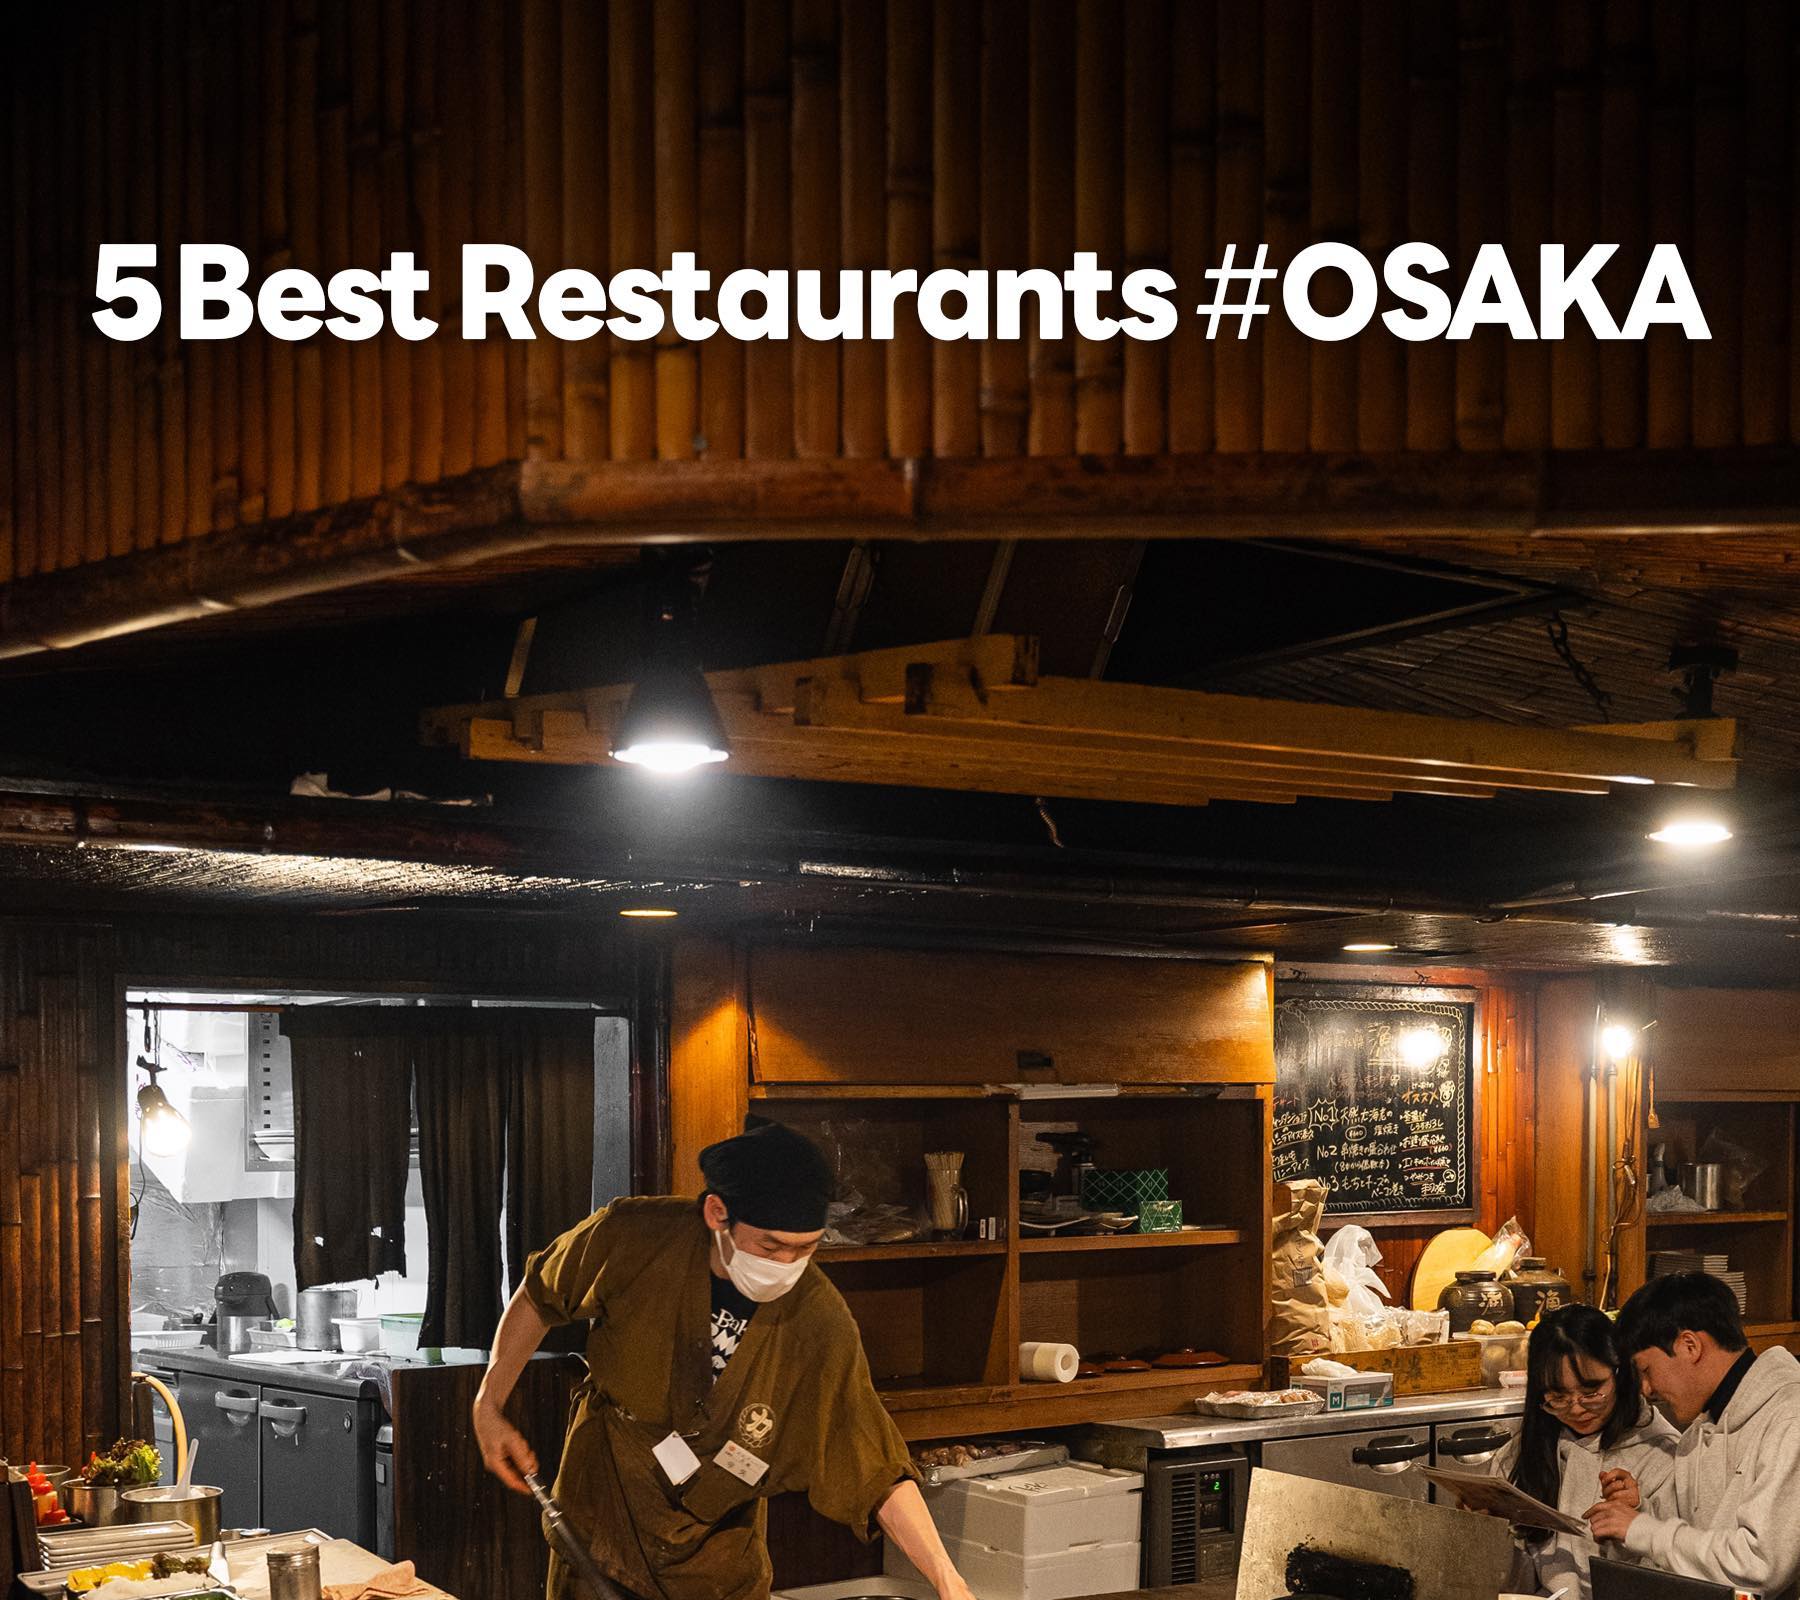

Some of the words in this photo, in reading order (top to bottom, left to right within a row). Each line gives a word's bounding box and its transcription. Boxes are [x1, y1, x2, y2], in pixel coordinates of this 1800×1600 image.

[1402, 1087, 1439, 1105] オススメ
[1213, 1481, 1220, 1490] 2
